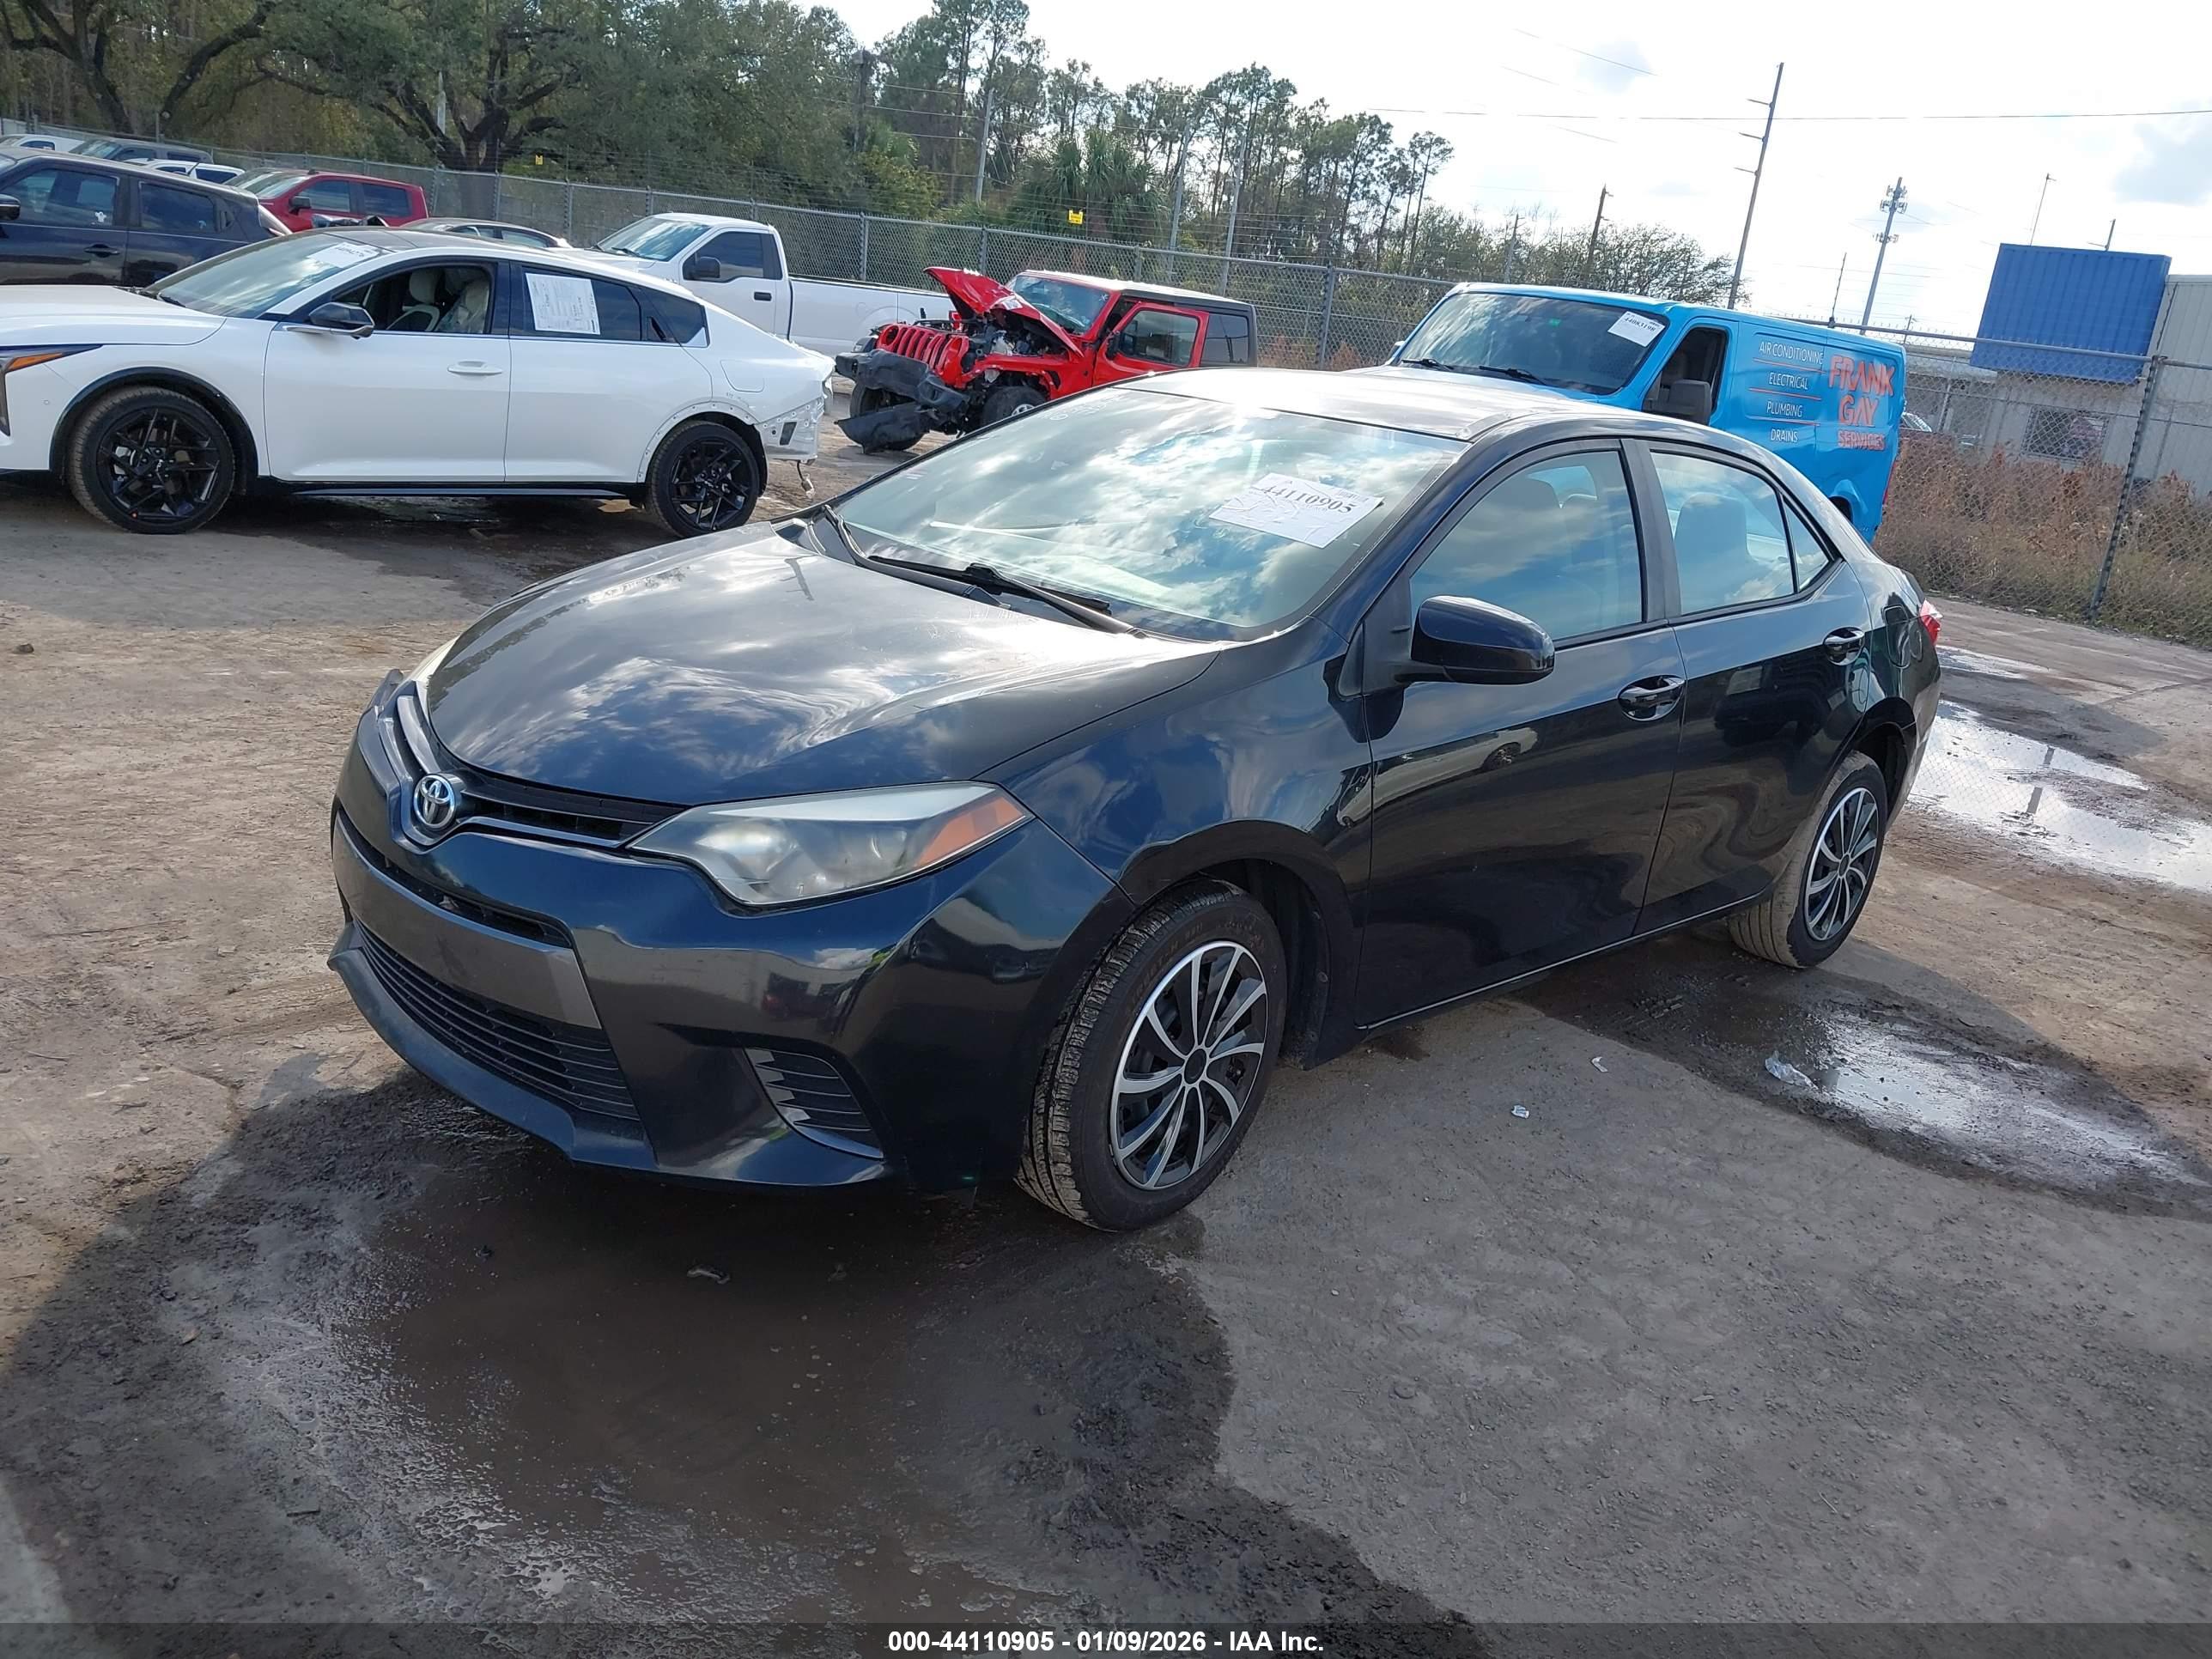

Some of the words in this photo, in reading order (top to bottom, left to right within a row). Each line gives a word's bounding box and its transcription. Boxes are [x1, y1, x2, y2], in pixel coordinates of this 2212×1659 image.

[1759, 341, 1772, 355] AIR
[1772, 343, 1824, 366] CONDITIONING
[1769, 372, 1808, 391] ELECTRICAL
[1828, 354, 1896, 397] FRANK
[1766, 401, 1802, 418] PLUMBING
[1838, 394, 1881, 428] GAY
[1770, 428, 1798, 443] DRAINS
[1838, 430, 1886, 451] SERVICES
[1262, 485, 1358, 514] 44110905
